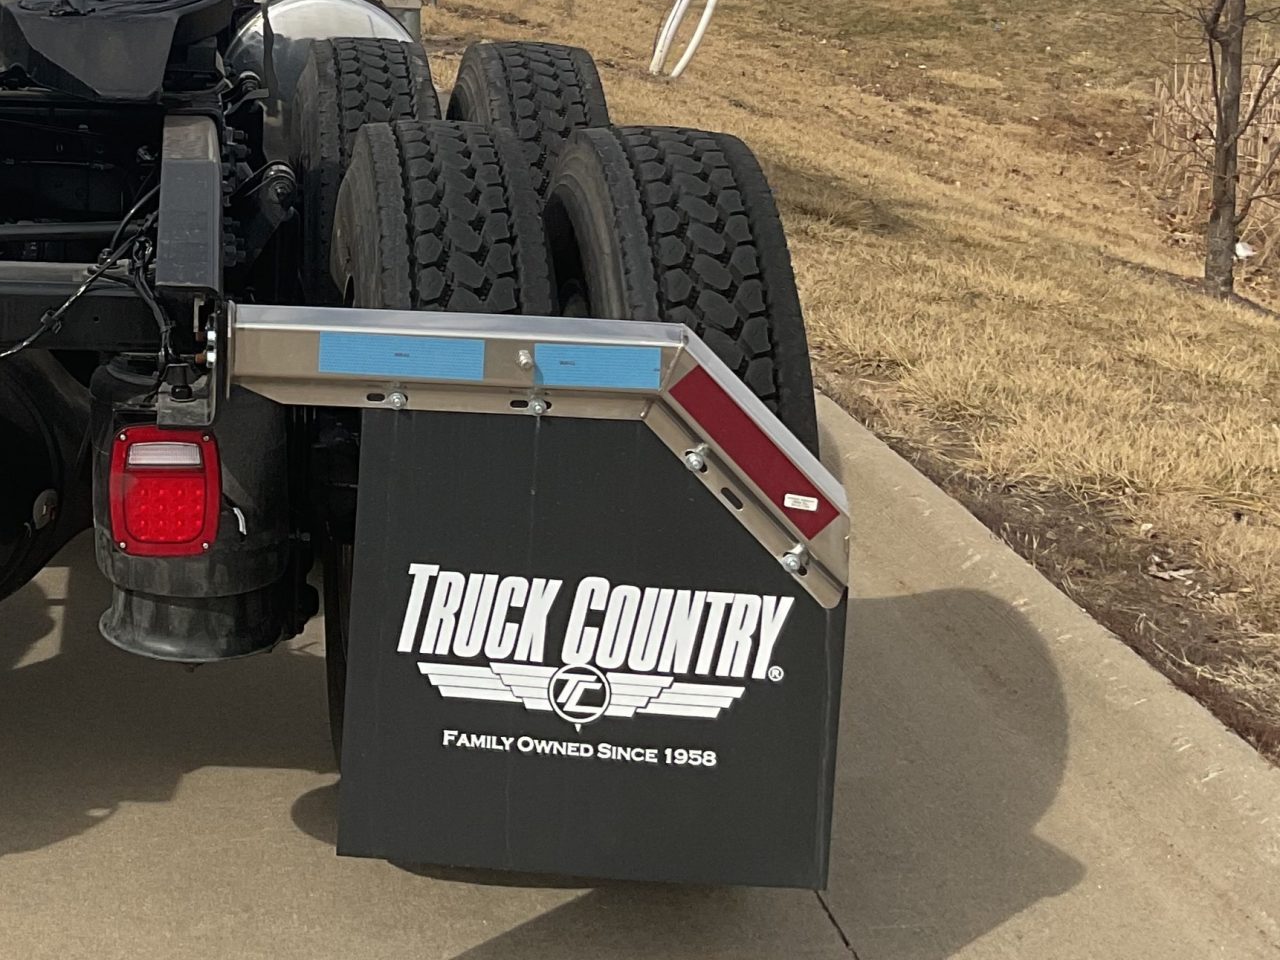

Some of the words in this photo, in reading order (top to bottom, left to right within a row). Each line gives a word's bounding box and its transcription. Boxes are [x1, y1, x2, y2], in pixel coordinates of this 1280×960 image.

[397, 563, 562, 662] TRUCK
[561, 577, 794, 679] COUNTRY
[442, 729, 514, 752] FAMILY
[517, 735, 594, 758] OWNED
[597, 742, 658, 764] SINCE
[664, 747, 717, 767] 1958
